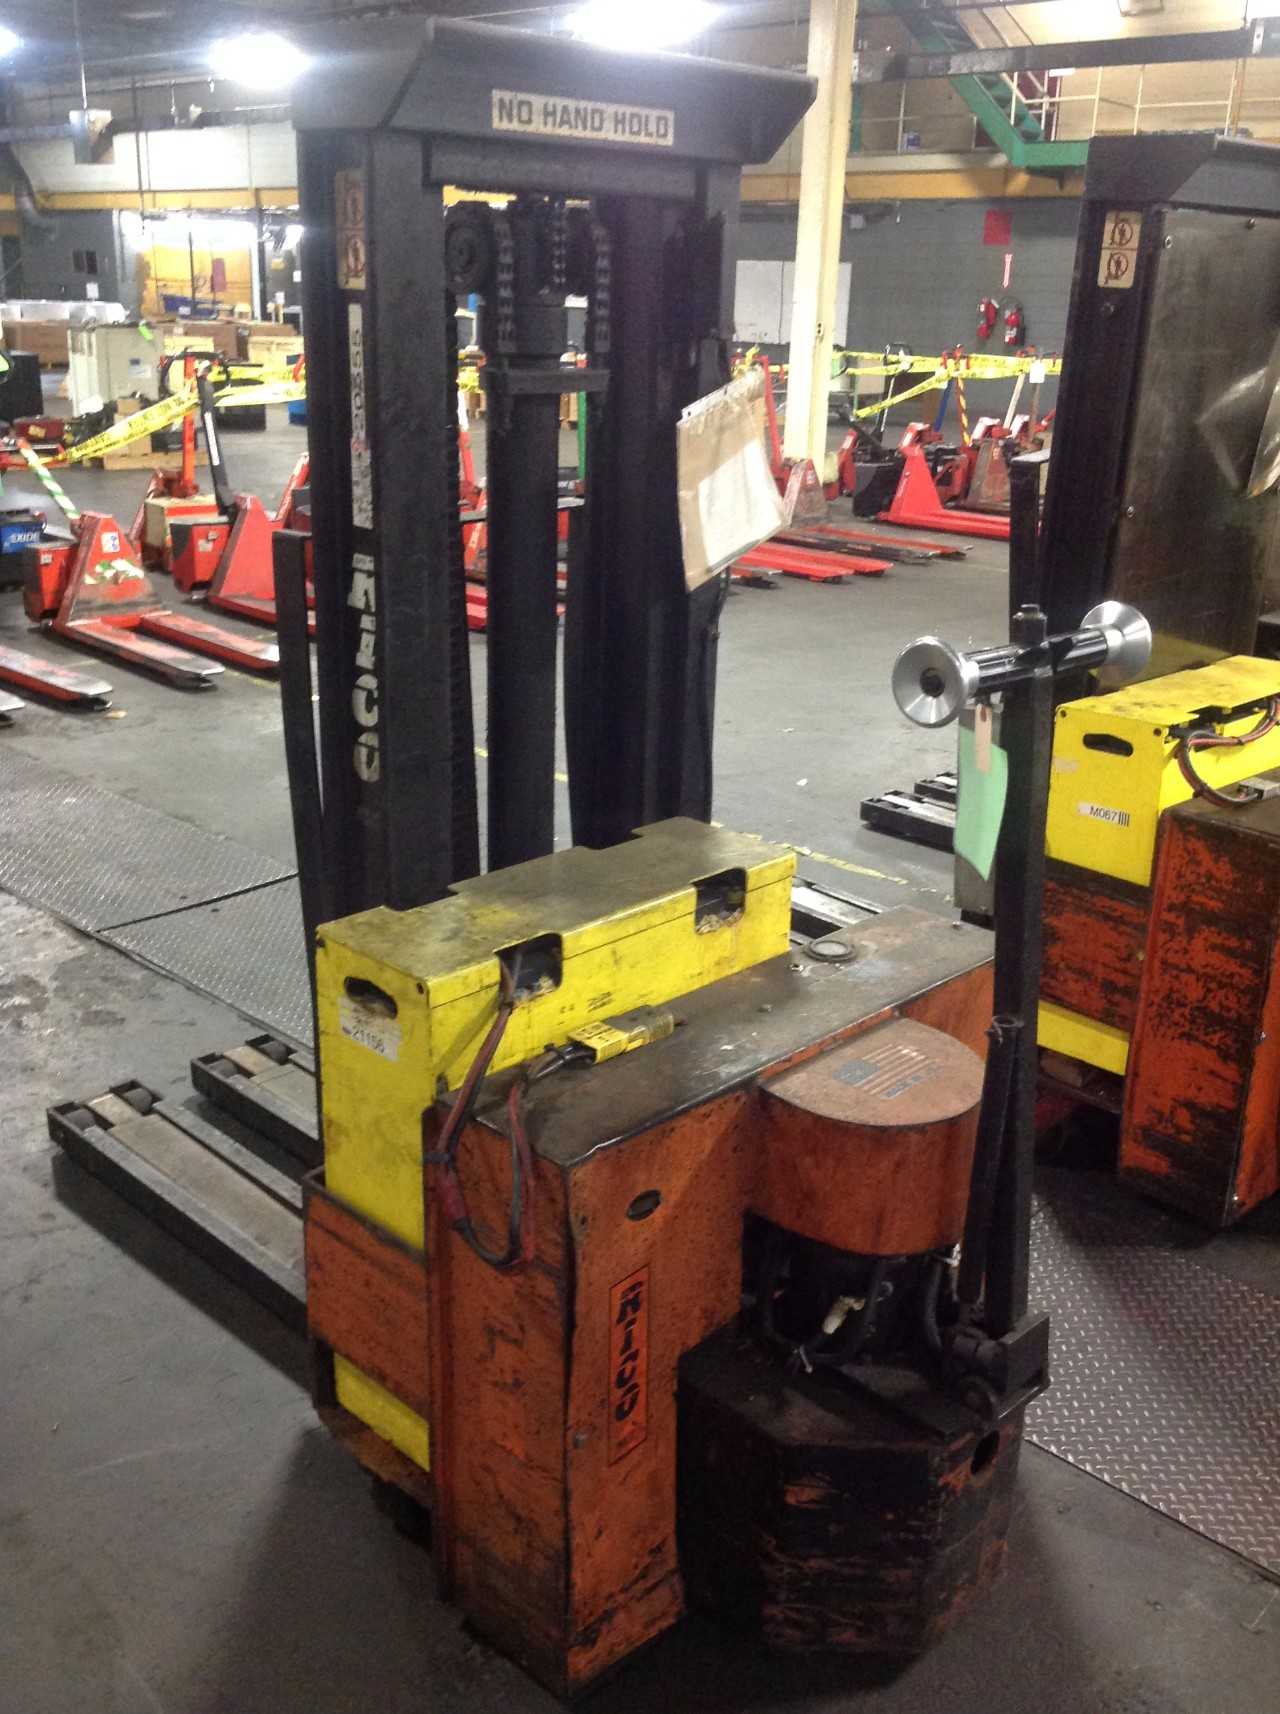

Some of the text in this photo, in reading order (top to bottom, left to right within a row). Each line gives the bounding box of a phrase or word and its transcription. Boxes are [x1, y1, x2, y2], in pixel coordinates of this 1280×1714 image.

[499, 97, 670, 139] NO HAND HOLD
